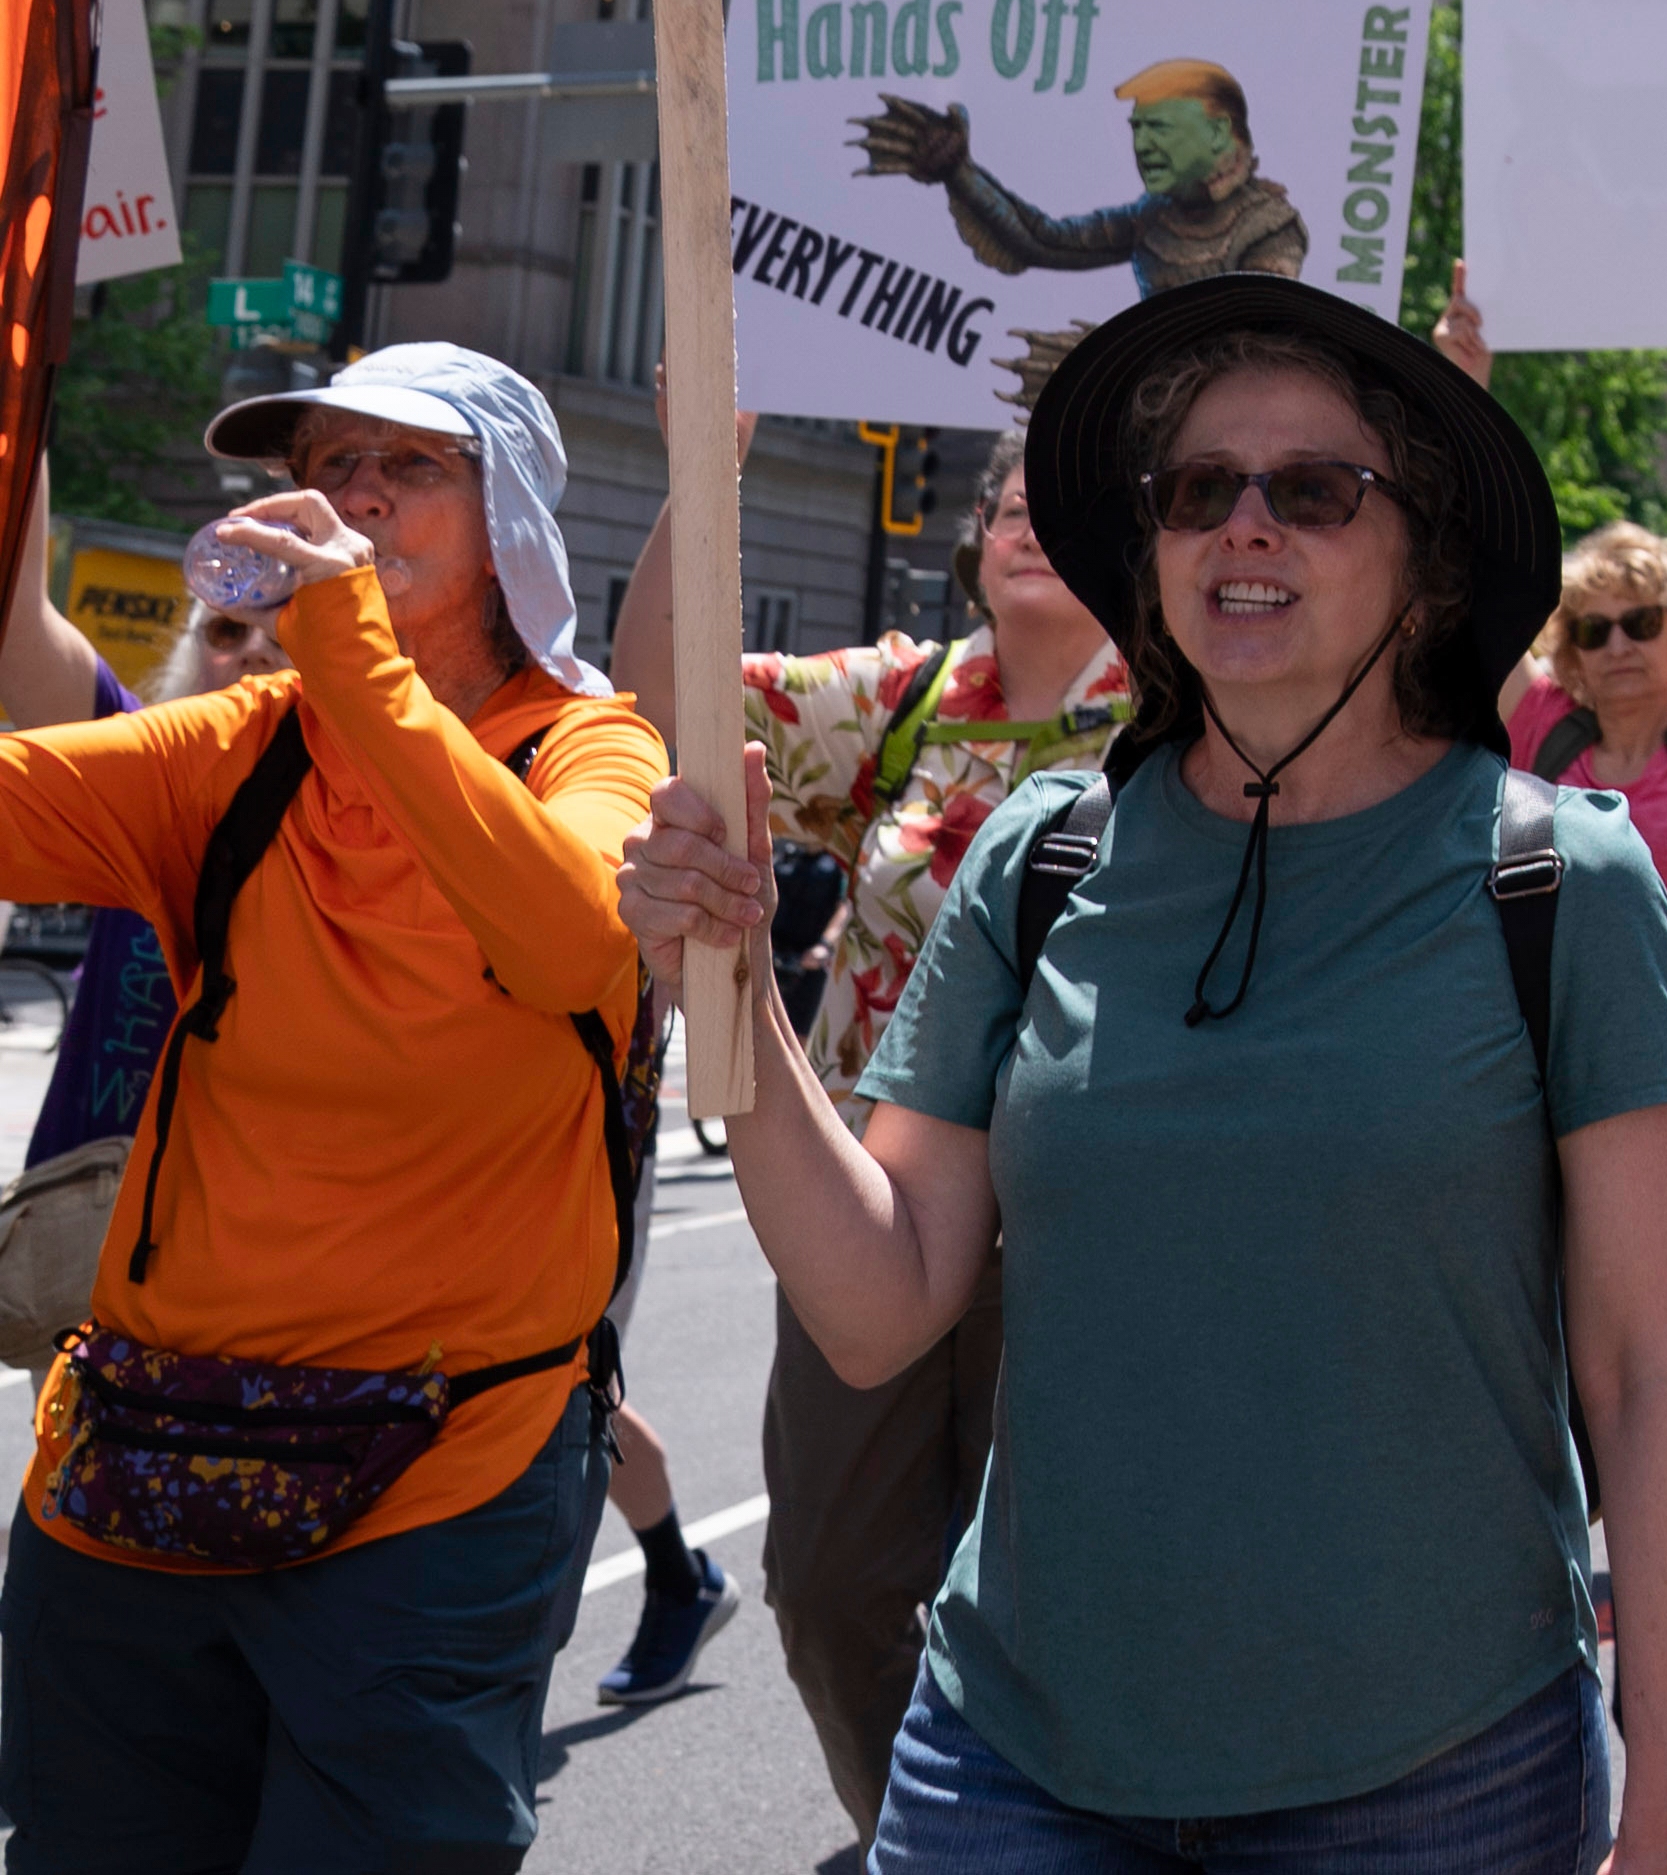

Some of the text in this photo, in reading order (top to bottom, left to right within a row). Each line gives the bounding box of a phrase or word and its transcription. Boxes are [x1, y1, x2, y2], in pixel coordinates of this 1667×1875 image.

[1336, 4, 1411, 286] MONSTER
[80, 190, 168, 241] air.
[233, 284, 262, 322] L
